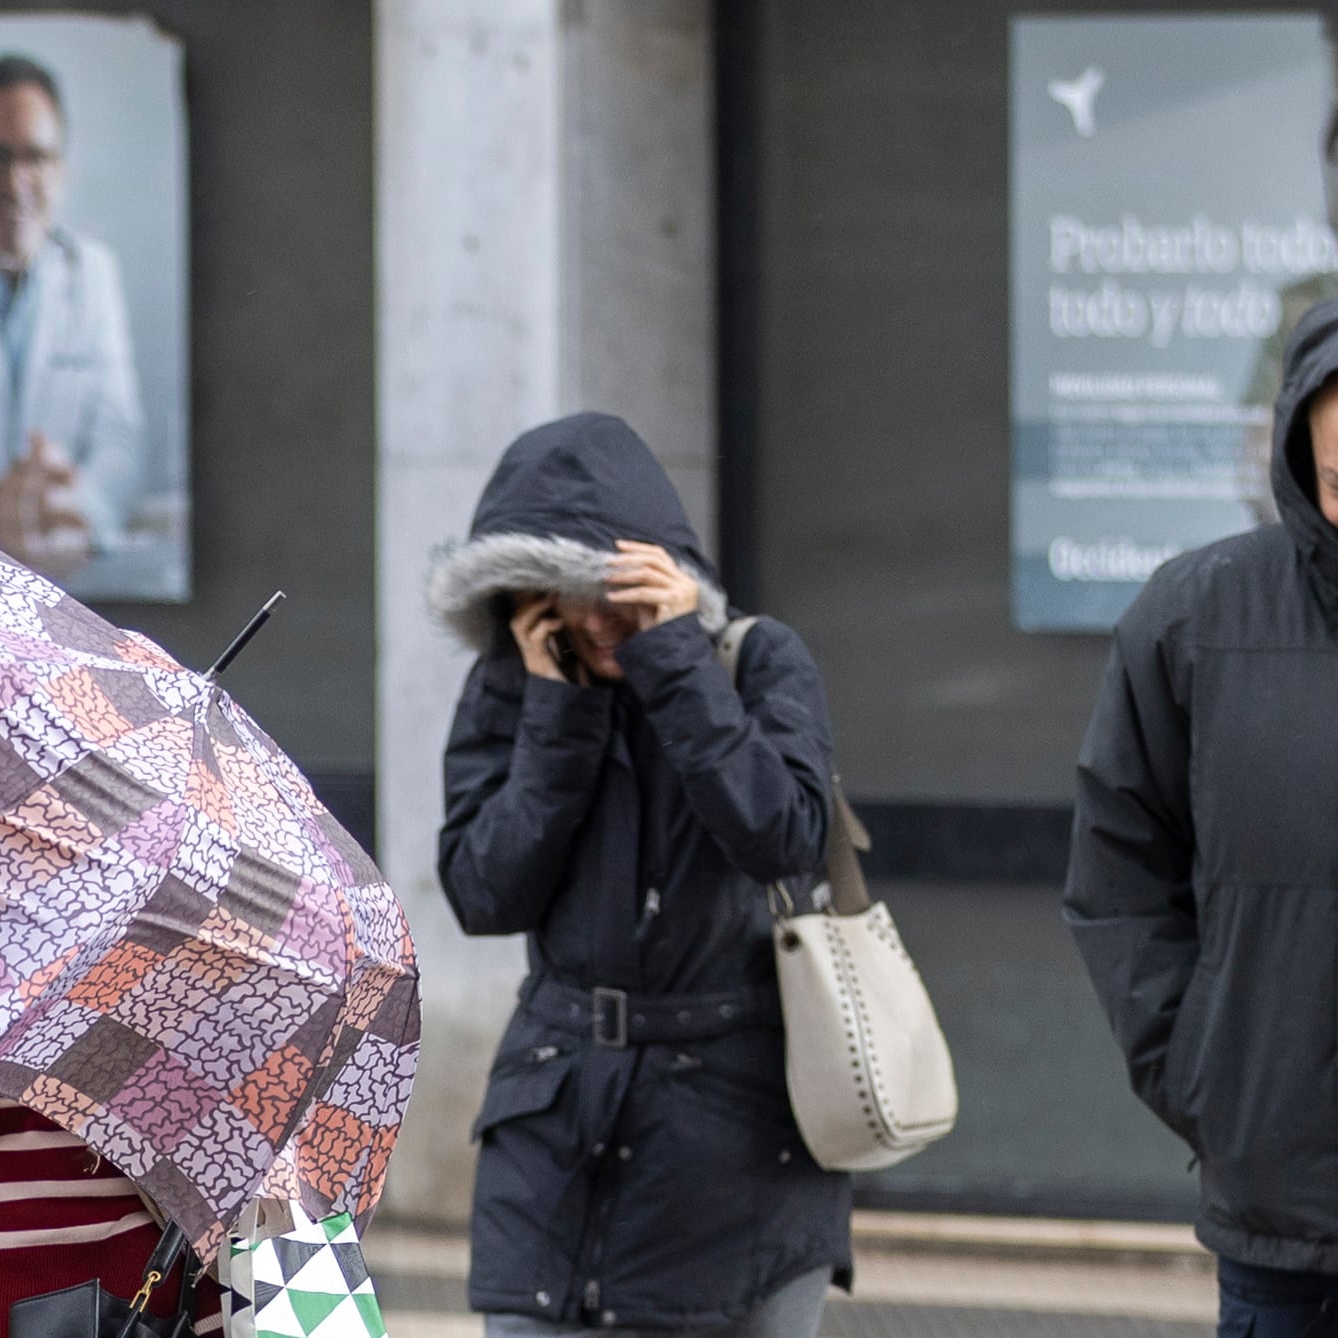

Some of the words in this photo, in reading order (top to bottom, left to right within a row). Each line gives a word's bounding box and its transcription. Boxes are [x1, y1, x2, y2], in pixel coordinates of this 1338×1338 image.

[1050, 214, 1239, 273] Probarlo
[1049, 281, 1148, 337] todo
[1152, 296, 1180, 347] y
[1182, 281, 1282, 337] todo
